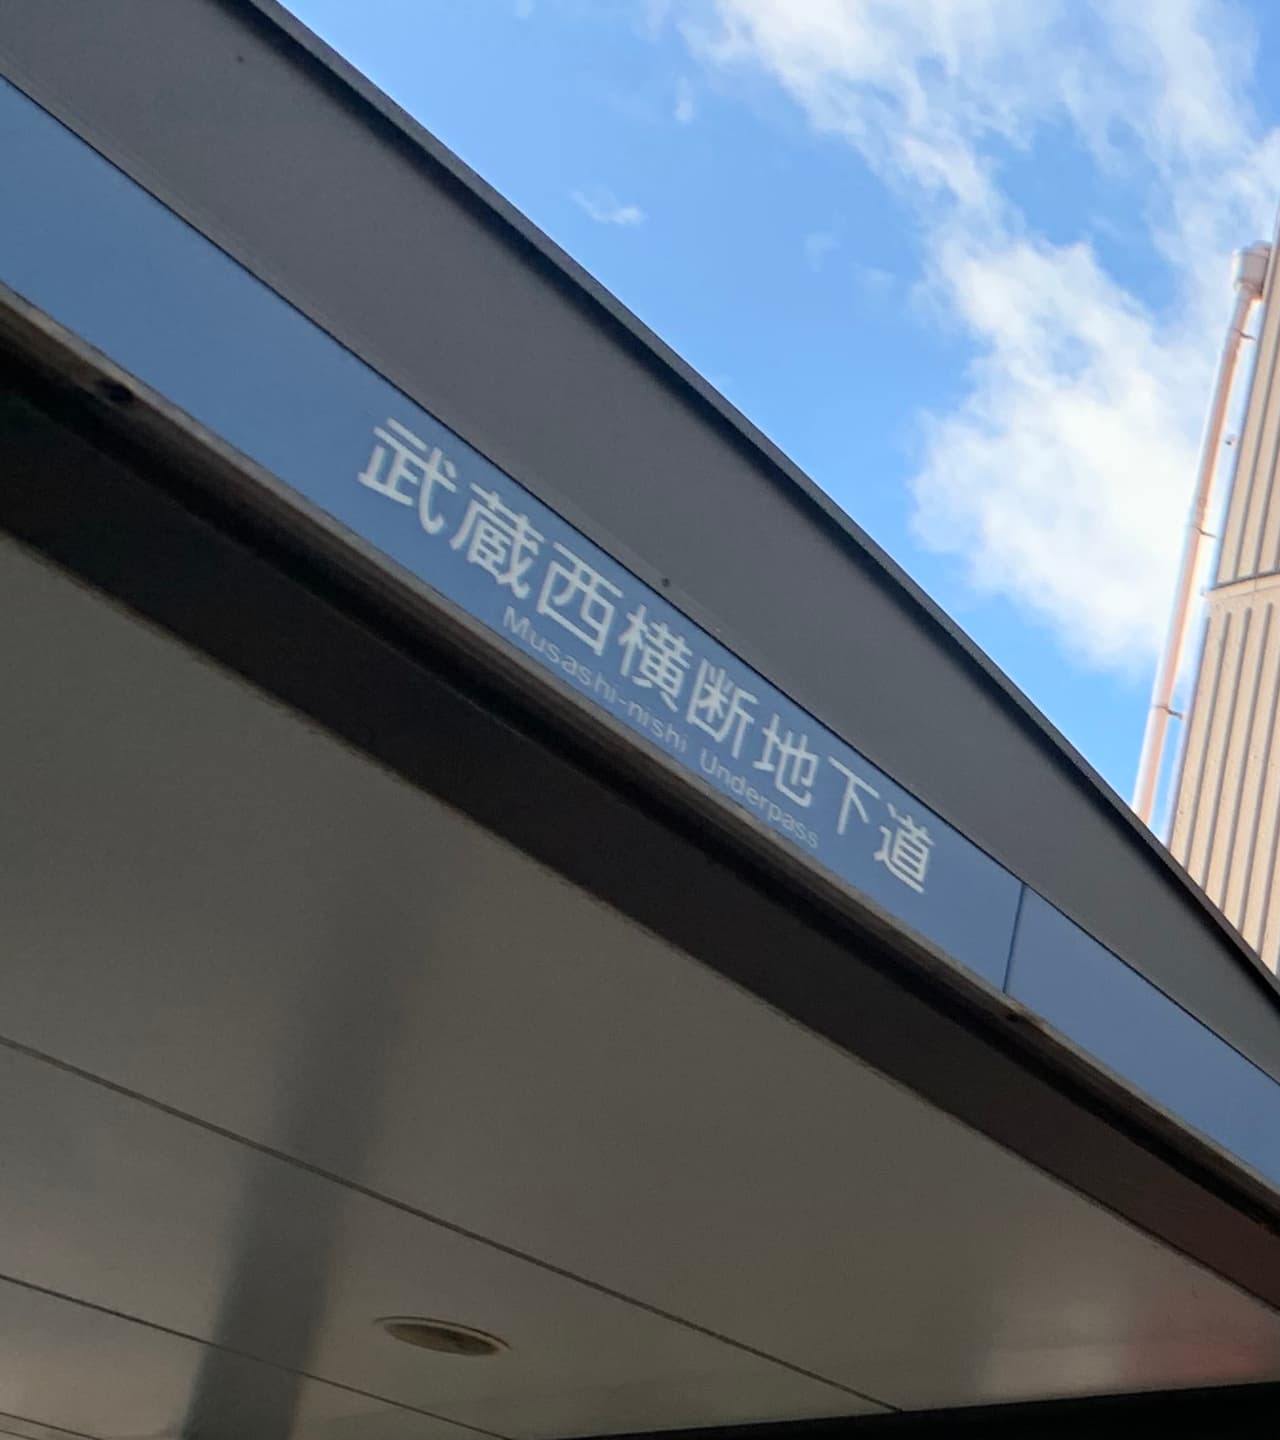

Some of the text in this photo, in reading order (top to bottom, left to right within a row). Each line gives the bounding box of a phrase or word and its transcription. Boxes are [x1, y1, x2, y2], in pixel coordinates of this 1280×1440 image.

[357, 417, 935, 894] 武蔵西横断地下道
[502, 606, 820, 850] Musashi-nishi Underpass
